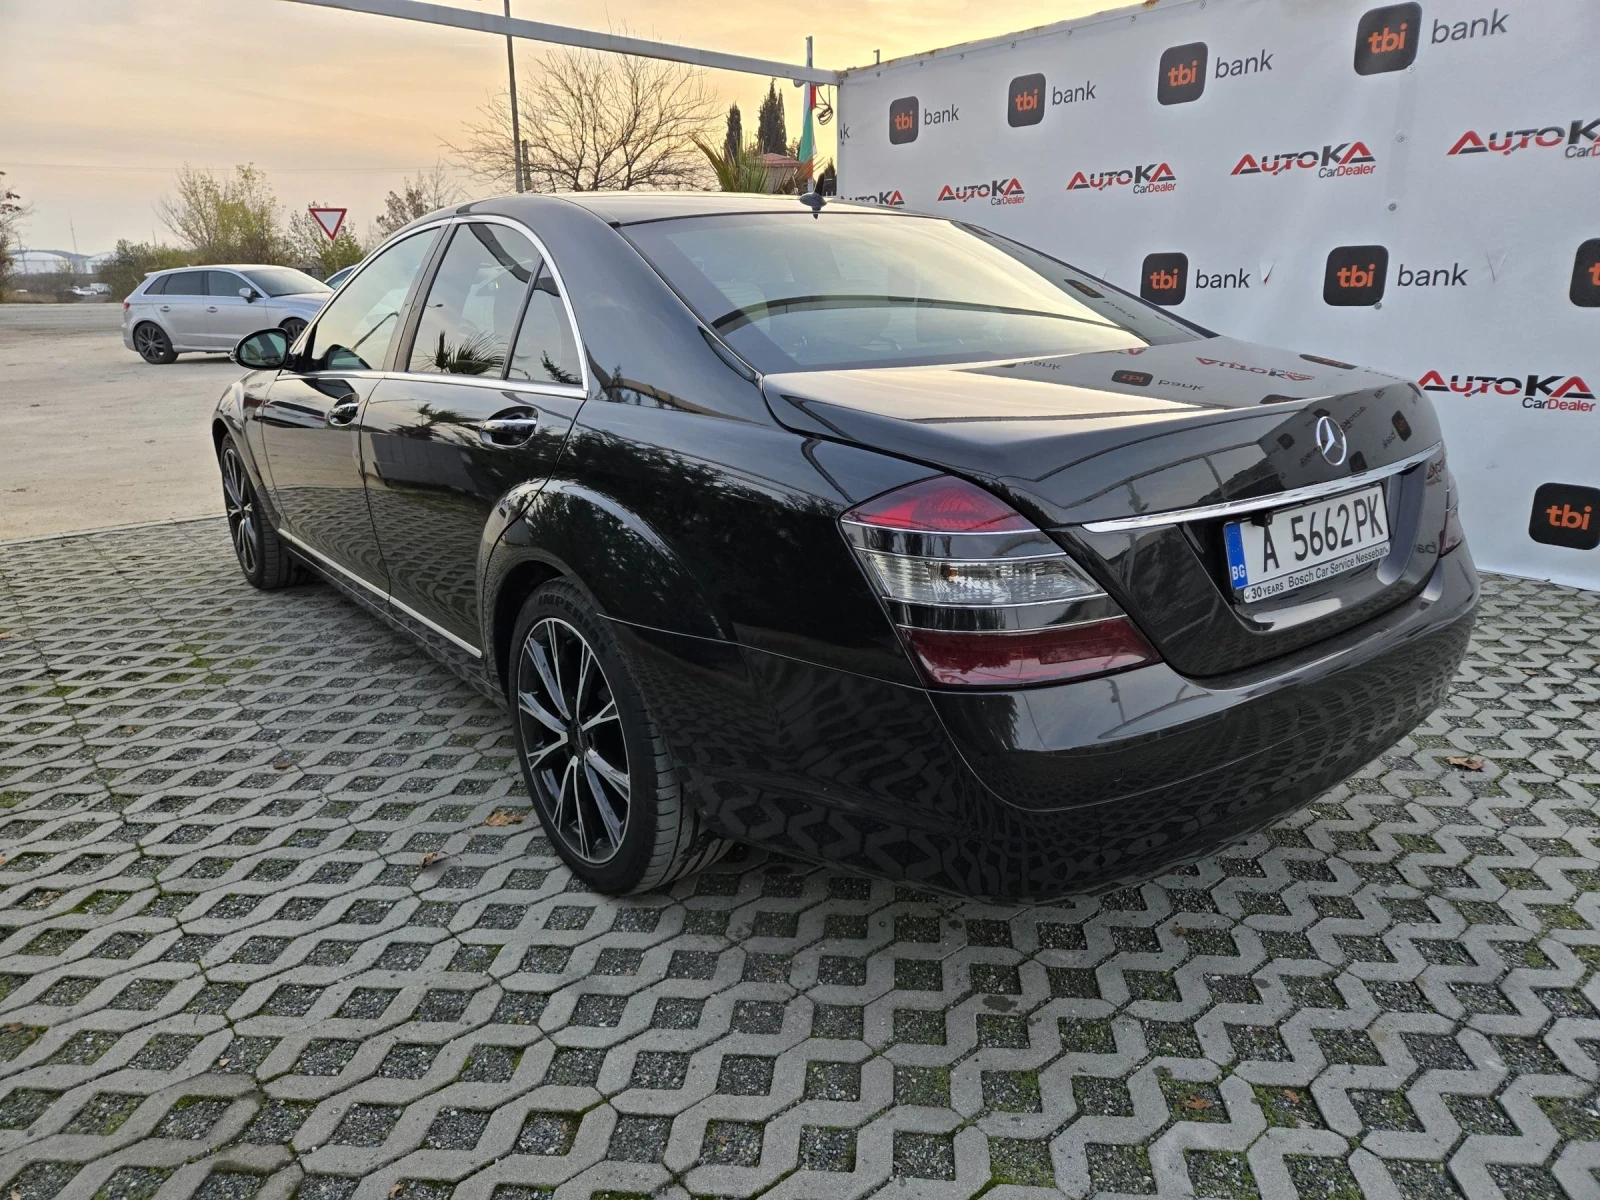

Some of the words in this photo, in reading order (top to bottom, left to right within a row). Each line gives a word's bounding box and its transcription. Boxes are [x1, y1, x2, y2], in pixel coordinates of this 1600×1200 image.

[1368, 23, 1408, 54] tbi
[1431, 8, 1510, 44] bank
[1168, 60, 1198, 87] tbi
[1215, 49, 1274, 79] bank
[1015, 89, 1038, 111] tbi
[1052, 81, 1097, 105] bank
[895, 110, 913, 130] tbi
[924, 104, 959, 126] bank
[1446, 117, 1600, 156] AUTOK
[1230, 141, 1376, 176] AUTOKA
[1318, 163, 1376, 179] CarDealer
[1066, 162, 1176, 191] AUTOKA
[1133, 181, 1177, 195] CarDealer
[937, 178, 1025, 202] AUTOKA
[991, 195, 1025, 206] CarDealer
[1150, 269, 1179, 291] tbi
[1196, 268, 1250, 290] bank
[1337, 263, 1375, 288] tbi
[1397, 263, 1469, 287] bank
[1418, 370, 1597, 399] AUTOKA
[1522, 397, 1596, 412] CarDealer
[1546, 504, 1592, 530] tbi
[1263, 524, 1280, 573] A
[1231, 563, 1246, 580] BG
[1251, 586, 1263, 599] 30
[1262, 582, 1284, 595] YEARS
[1288, 570, 1314, 587] Bosch
[1316, 566, 1329, 579] Car
[1330, 558, 1354, 574] Service
[1355, 545, 1386, 564] Nessebar
